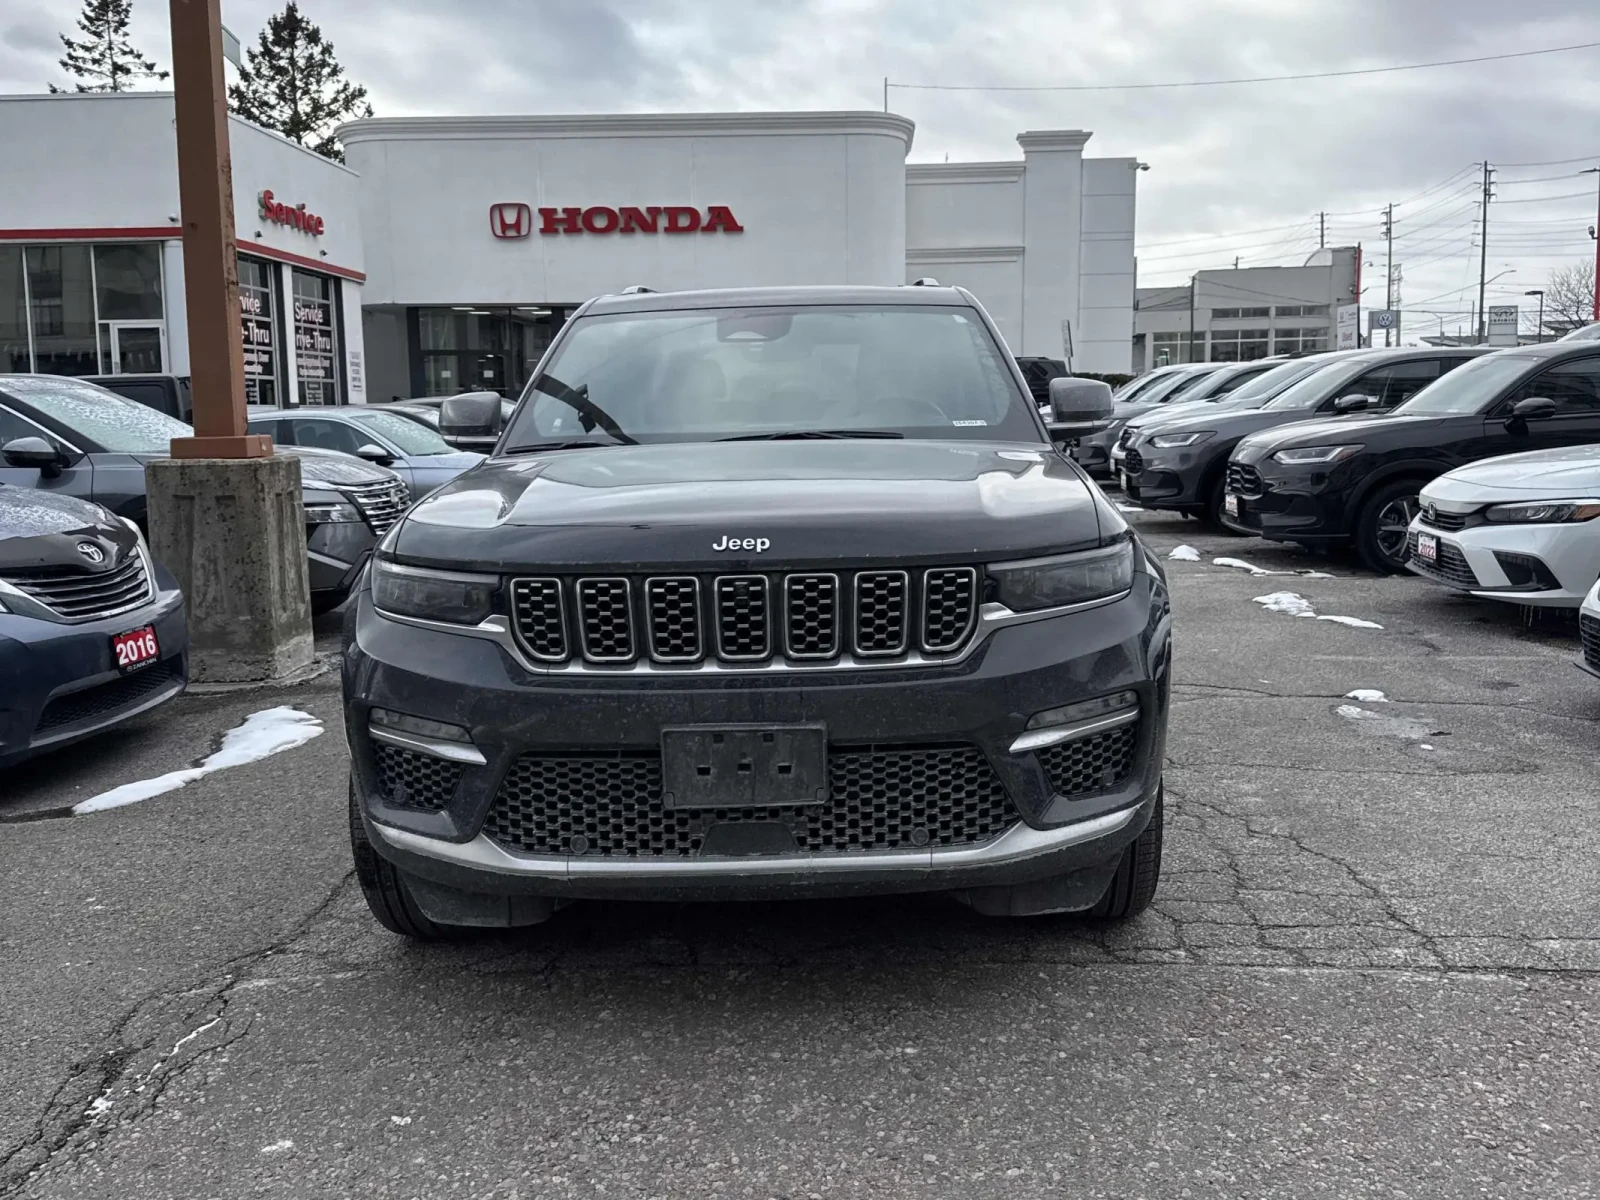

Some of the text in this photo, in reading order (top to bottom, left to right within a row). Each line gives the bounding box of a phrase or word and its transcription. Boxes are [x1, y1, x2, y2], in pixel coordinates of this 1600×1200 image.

[258, 189, 324, 236] Service
[538, 206, 744, 234] HONDA
[295, 302, 323, 323] Service
[296, 329, 331, 350] rive-Thru
[712, 535, 770, 553] Jeep
[1420, 543, 1434, 557] 2022
[116, 634, 156, 665] 2016
